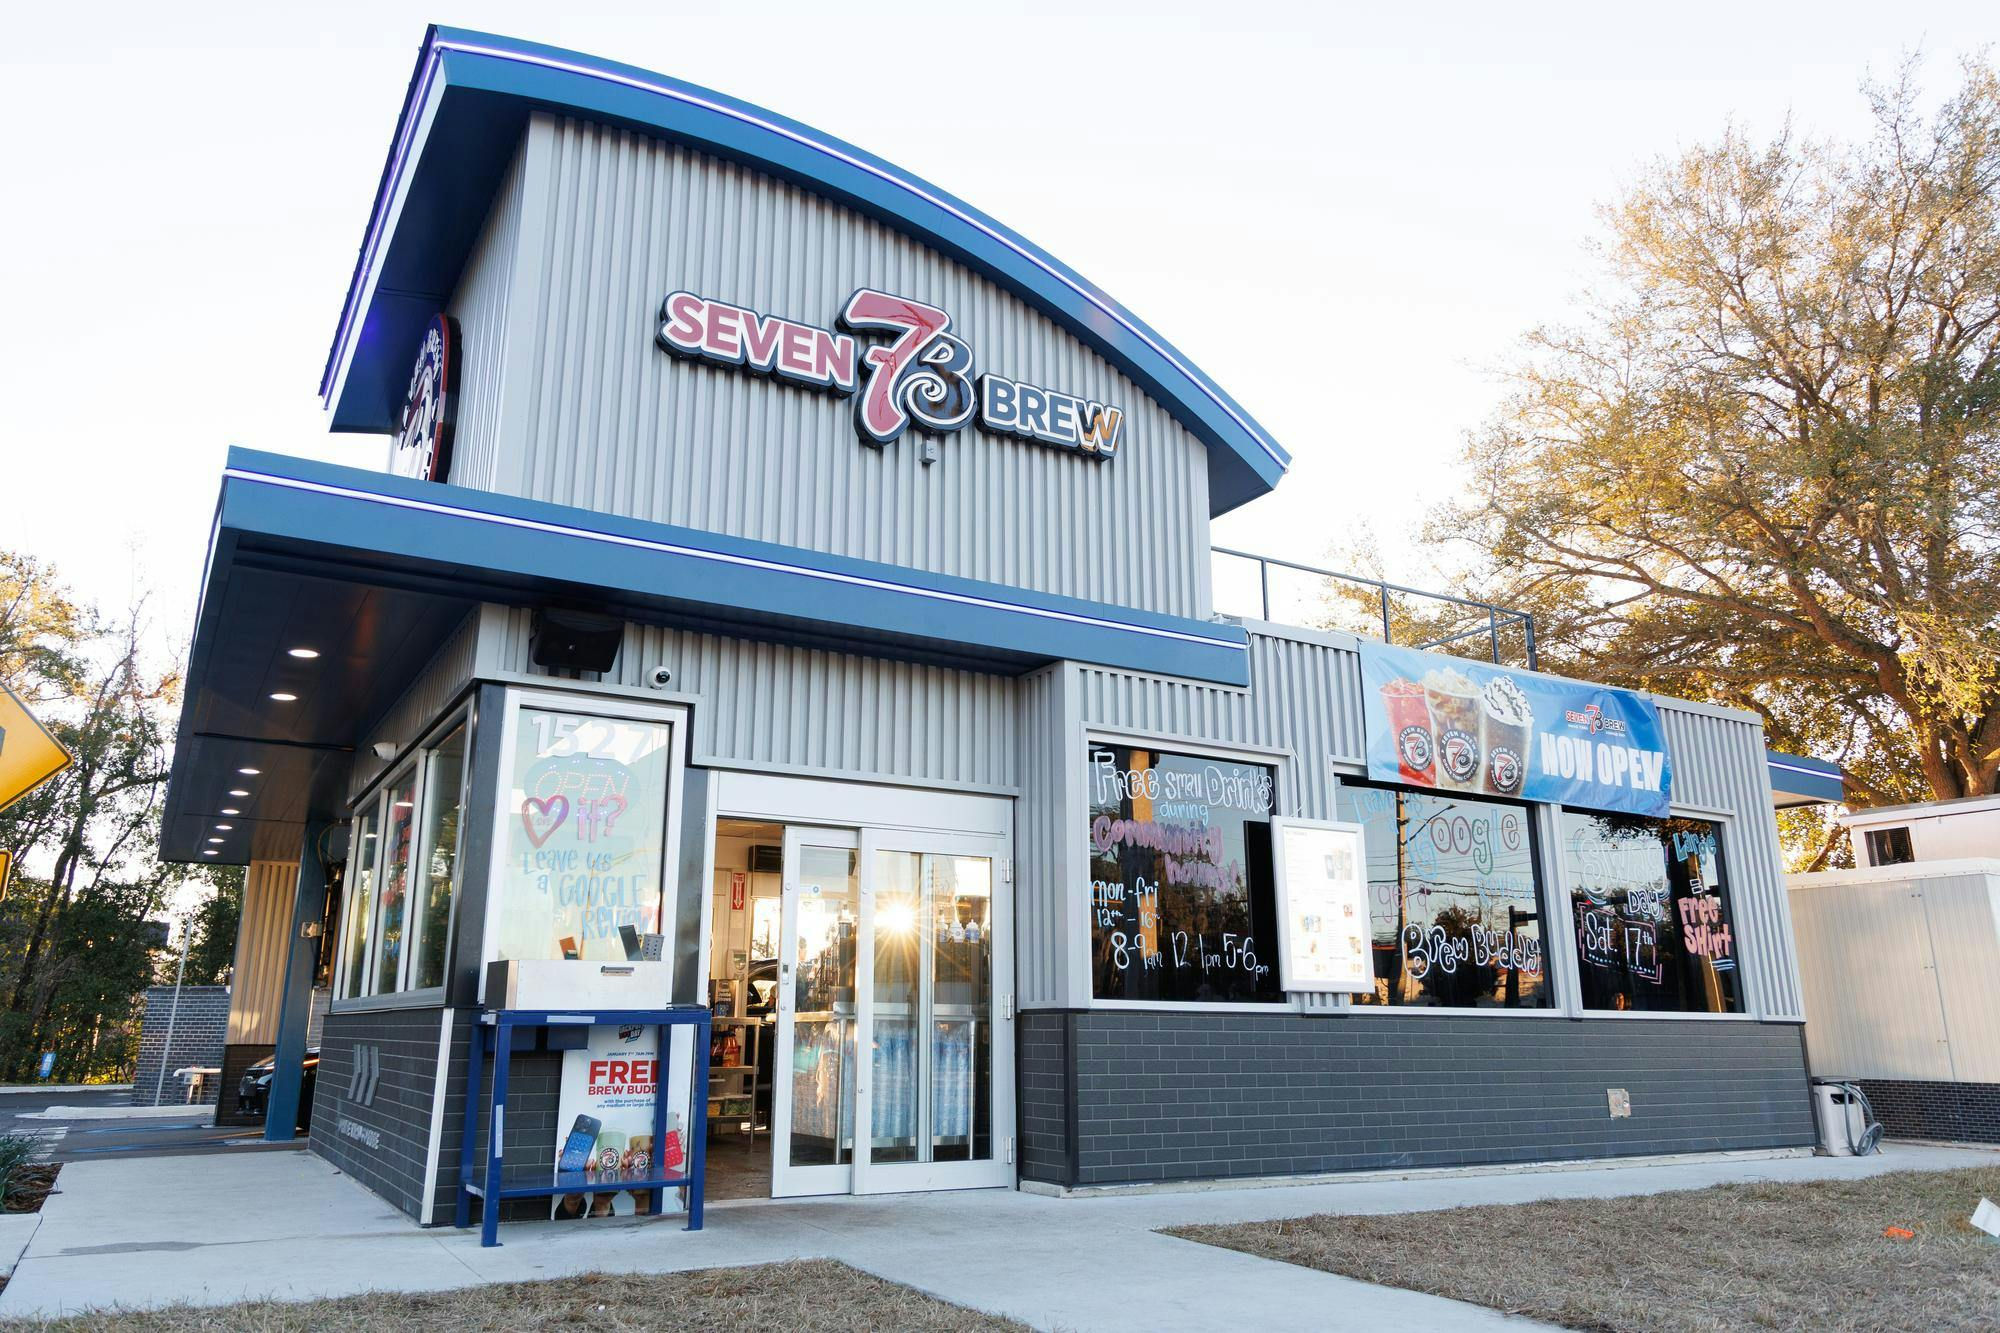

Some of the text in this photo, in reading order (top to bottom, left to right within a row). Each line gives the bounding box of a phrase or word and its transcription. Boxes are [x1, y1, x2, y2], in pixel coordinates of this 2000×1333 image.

[664, 292, 857, 390] SEVEN
[981, 374, 1122, 453] BREW
[1566, 711, 1588, 724] SEVEN
[1604, 718, 1626, 731] BREW
[1540, 731, 1664, 792] NOW OPEN
[535, 769, 630, 800] OPEN
[1093, 751, 1161, 805] Free
[1204, 765, 1274, 814] Drinks
[1159, 800, 1209, 826] during
[523, 848, 578, 875] Leave
[559, 873, 648, 908] GOOGLE
[1586, 911, 1618, 954] Sat.
[1402, 922, 1469, 979] Brew
[1470, 923, 1541, 978] Buddy
[588, 1085, 625, 1096] BREW
